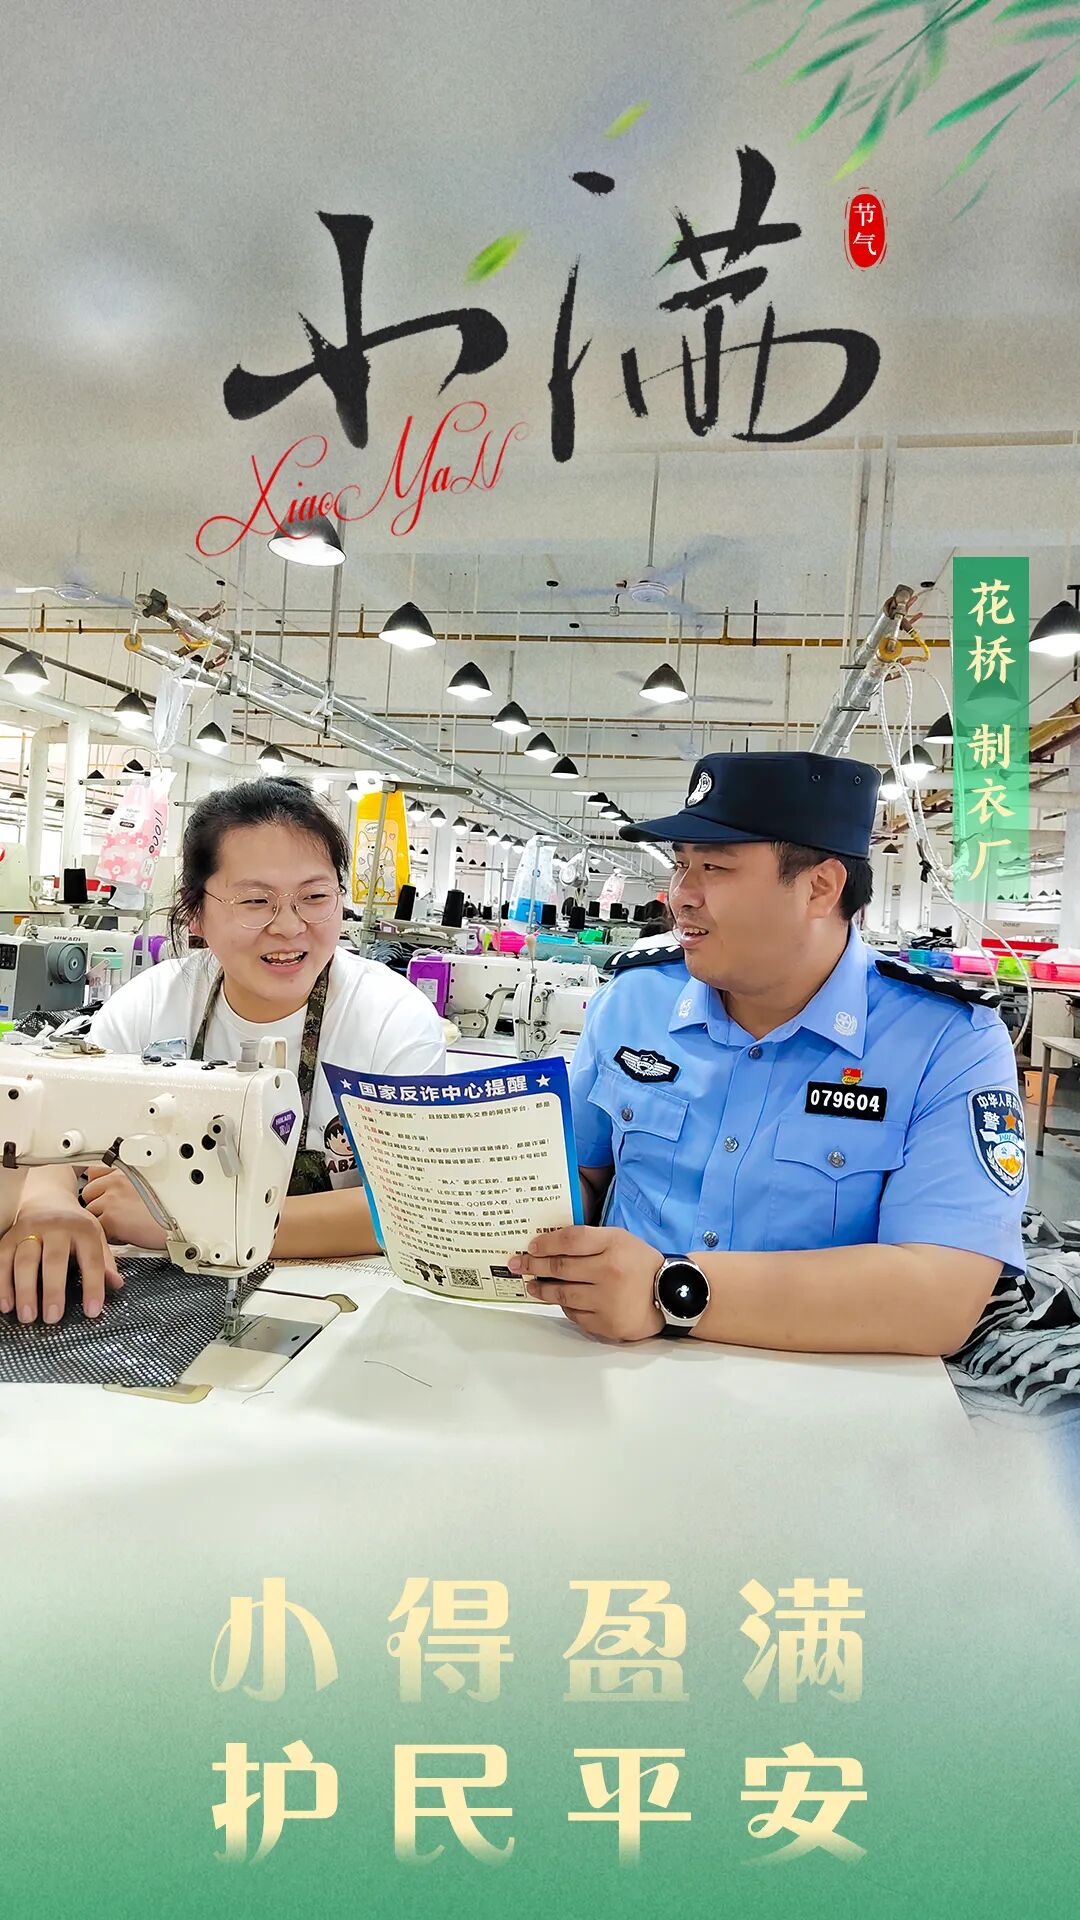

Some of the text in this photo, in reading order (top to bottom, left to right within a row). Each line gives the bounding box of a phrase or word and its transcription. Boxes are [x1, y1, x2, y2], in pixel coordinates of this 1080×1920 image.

[357, 1074, 529, 1102] 国家反诈中心提醒
[810, 1089, 880, 1112] 079604
